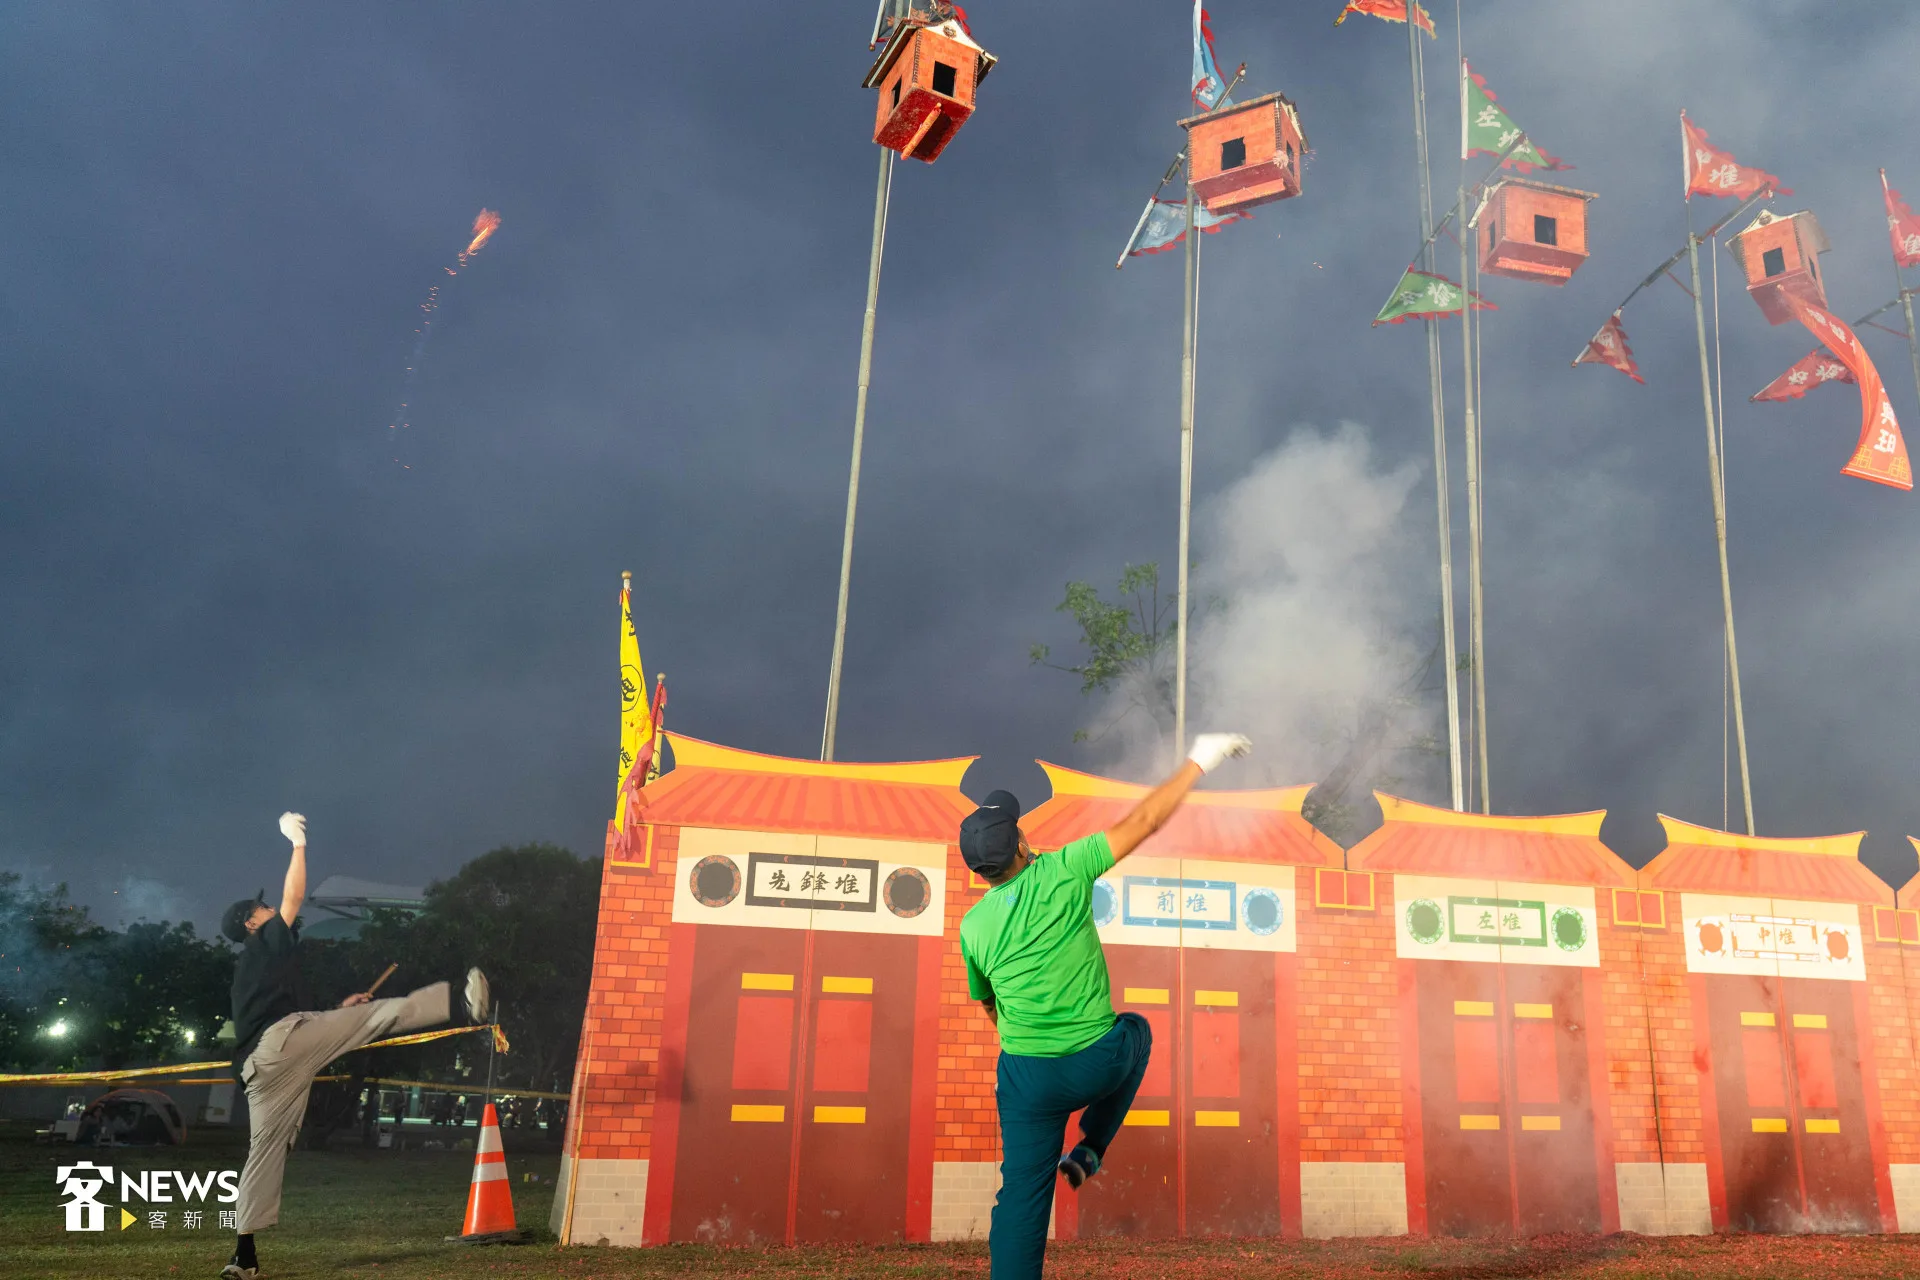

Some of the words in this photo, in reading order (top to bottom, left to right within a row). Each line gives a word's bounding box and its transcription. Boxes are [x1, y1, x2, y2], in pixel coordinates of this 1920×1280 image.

[769, 869, 860, 895] 先鋒堆
[1157, 889, 1208, 914] 前堆
[1477, 910, 1523, 931] 左堆
[1757, 926, 1796, 946] 中堆
